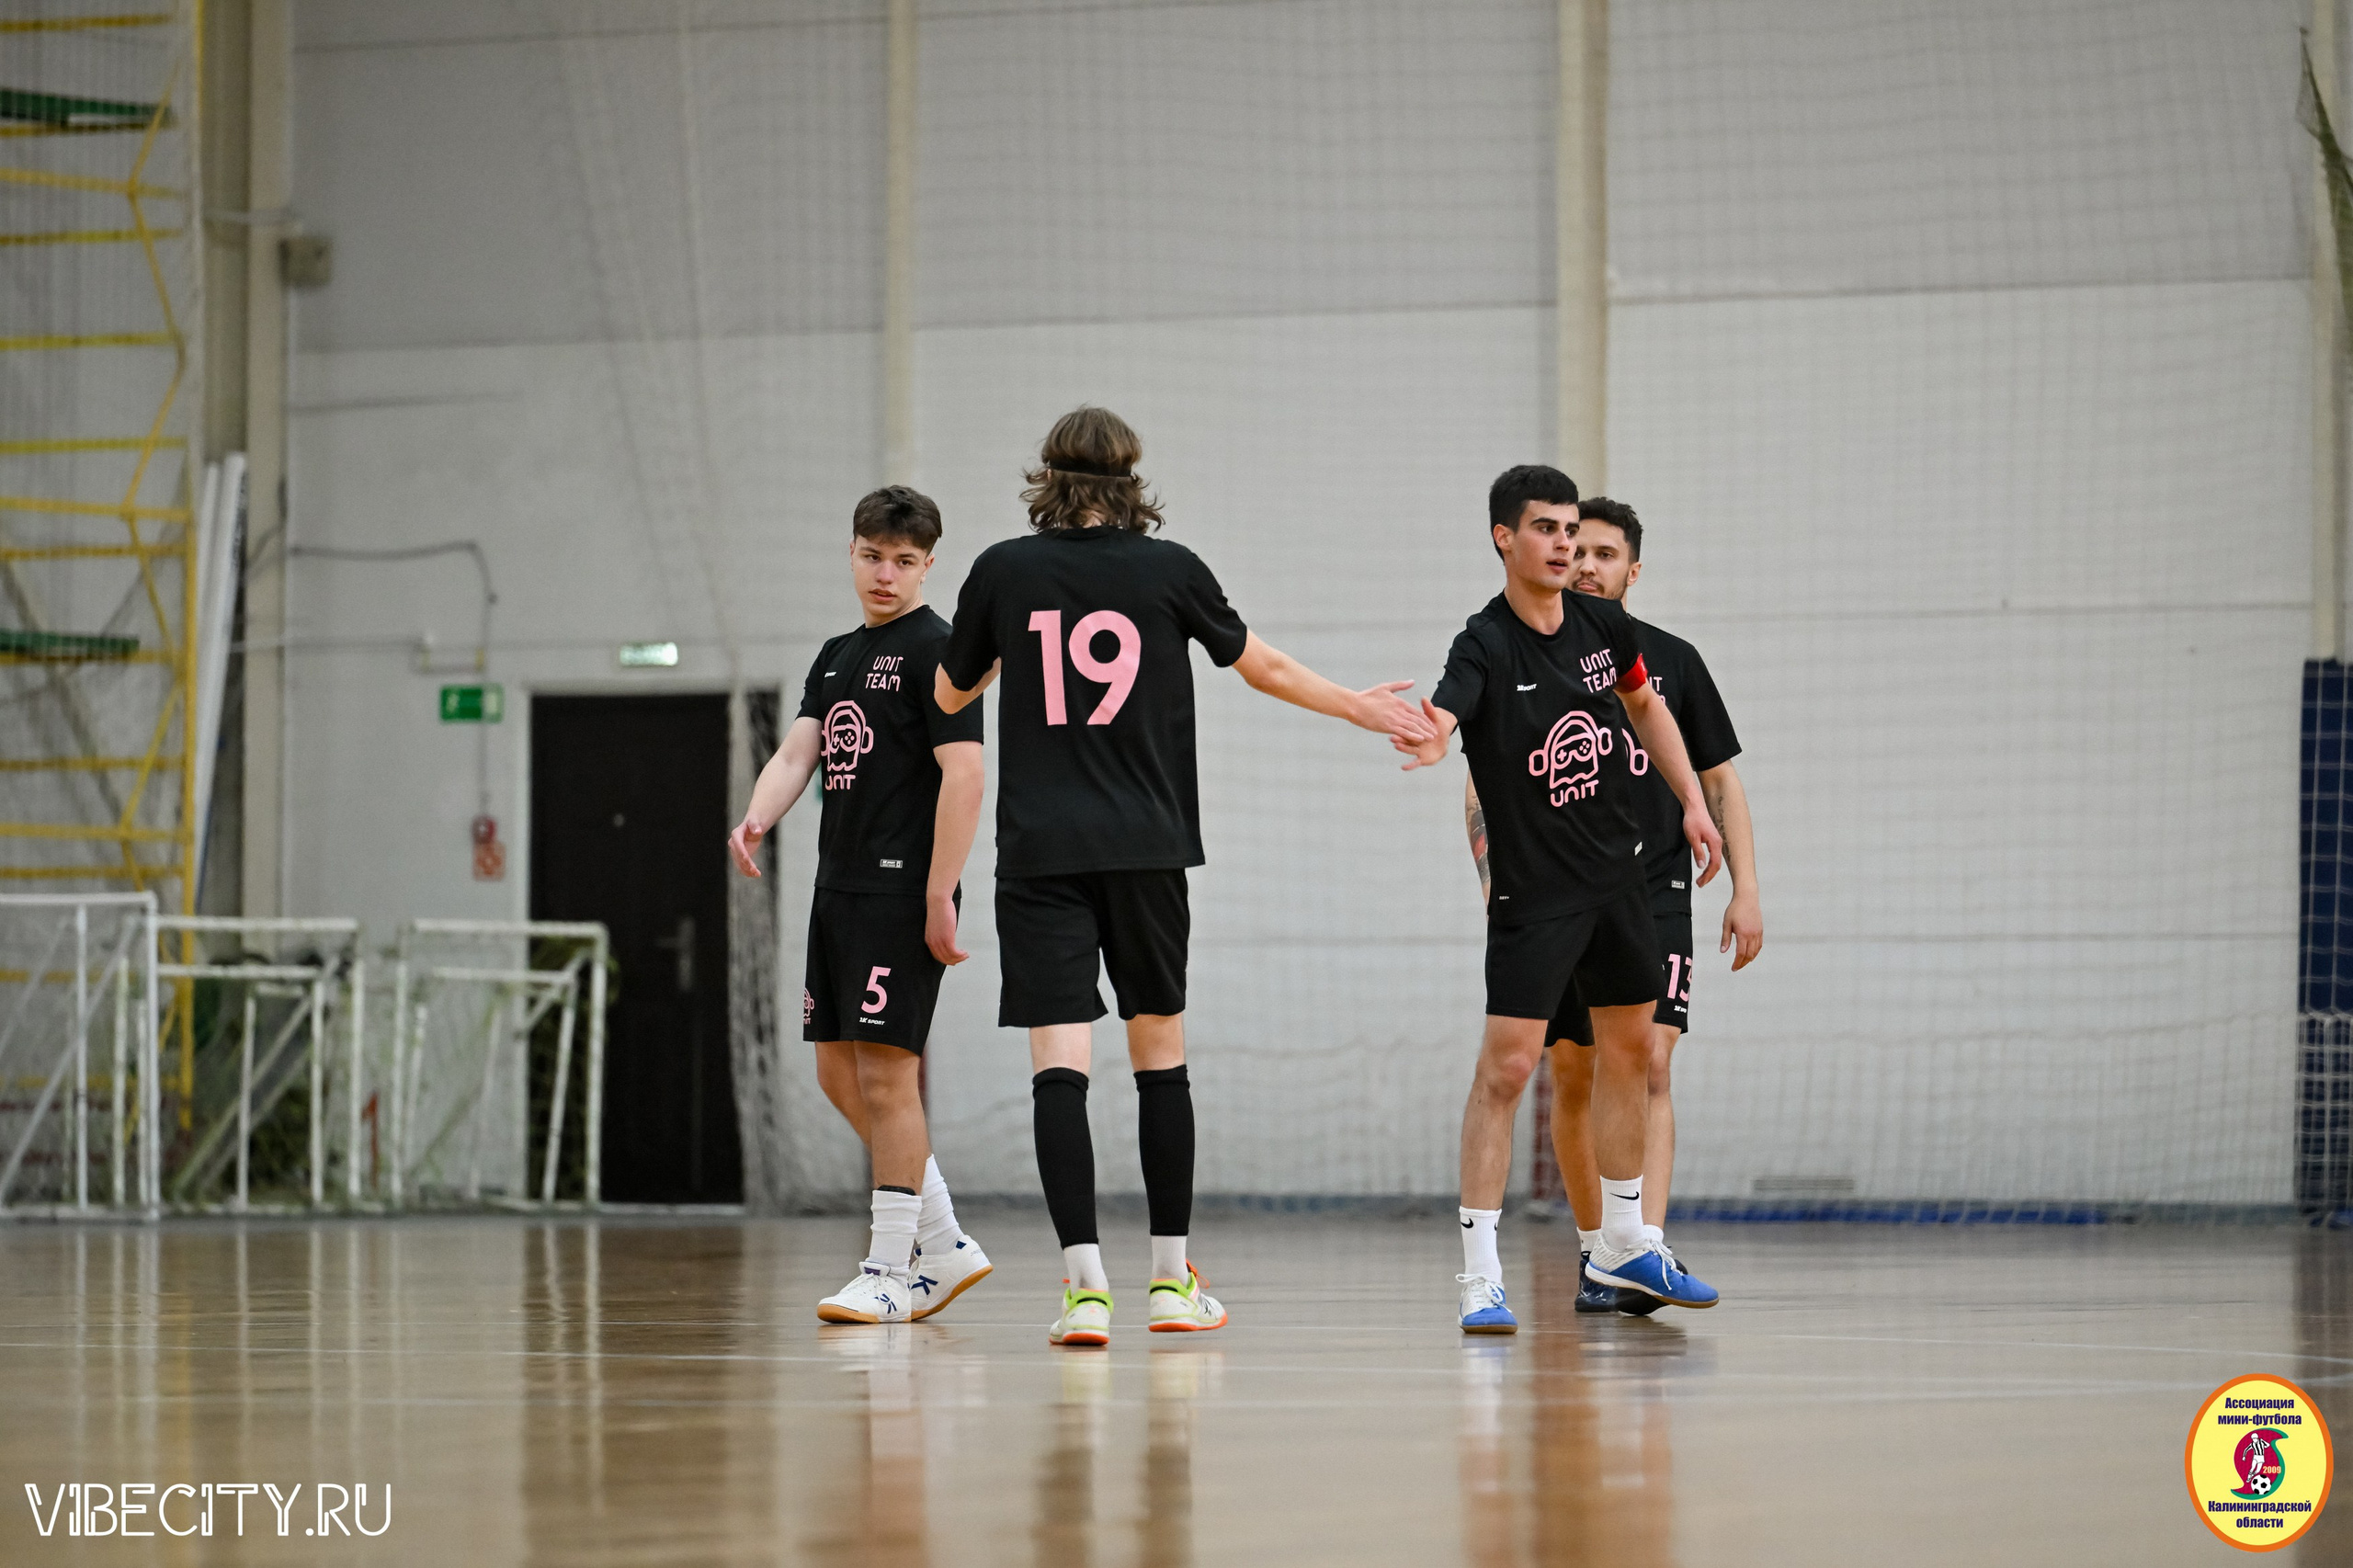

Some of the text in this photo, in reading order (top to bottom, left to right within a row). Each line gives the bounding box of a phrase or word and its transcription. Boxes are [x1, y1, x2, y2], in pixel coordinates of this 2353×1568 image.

[872, 655, 904, 672] UNIT
[1028, 609, 1142, 725] 19
[1579, 648, 1613, 674] UNIT
[865, 673, 901, 692] TEAM
[1583, 666, 1617, 694] TEAM
[1551, 779, 1599, 808] UNIT
[860, 965, 892, 1014] 5
